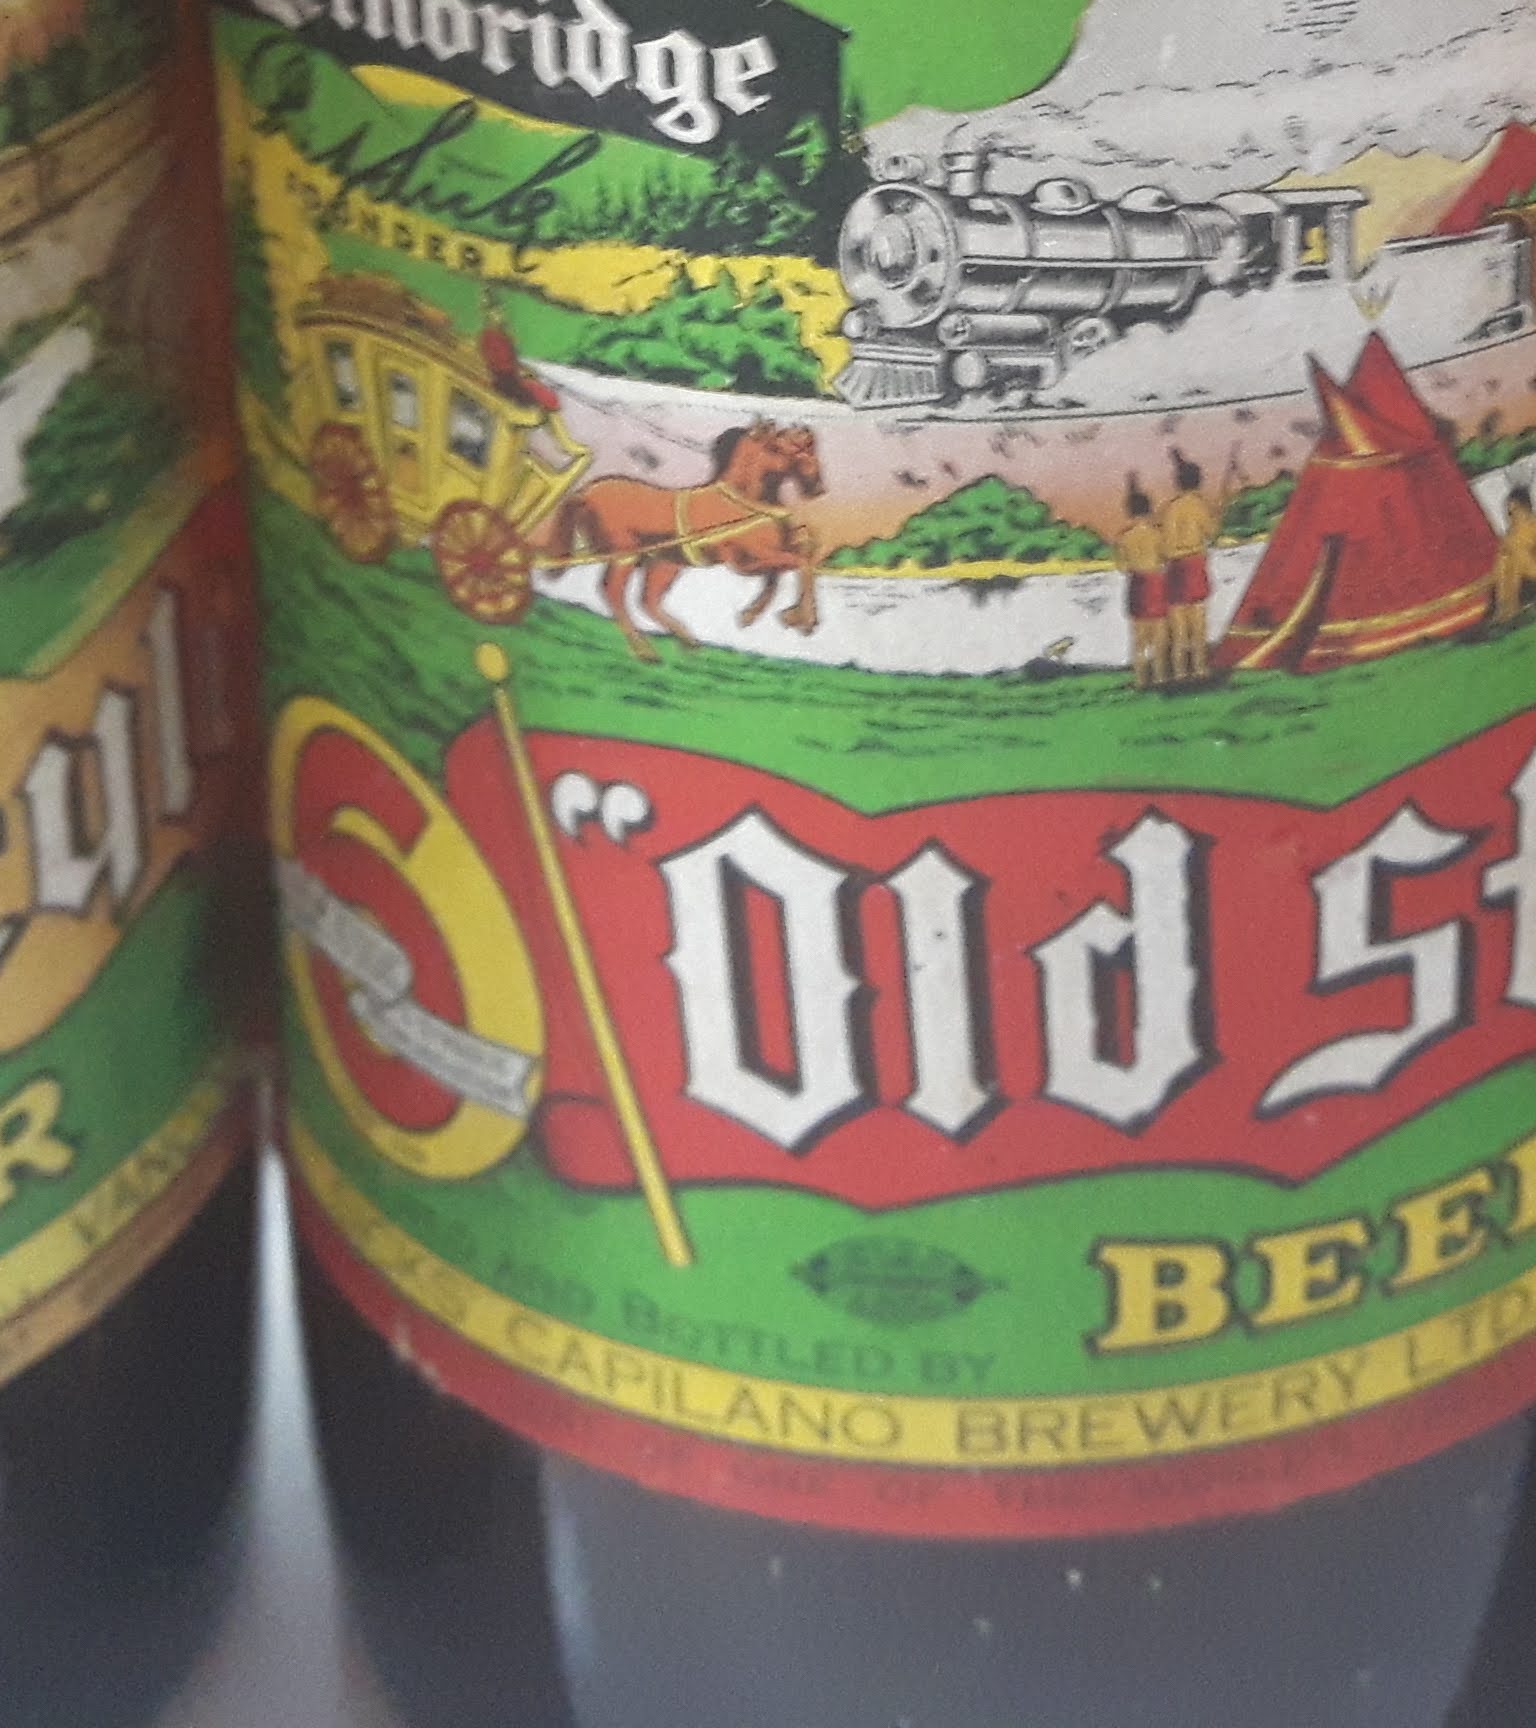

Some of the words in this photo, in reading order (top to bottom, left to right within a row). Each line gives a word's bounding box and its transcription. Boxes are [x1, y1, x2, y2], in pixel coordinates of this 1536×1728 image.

[504, 1313, 904, 1454] CAPILANO
[955, 1355, 1367, 1455] BREWERY
[617, 1286, 896, 1381] BOTTLED
[919, 1349, 998, 1384] BY
